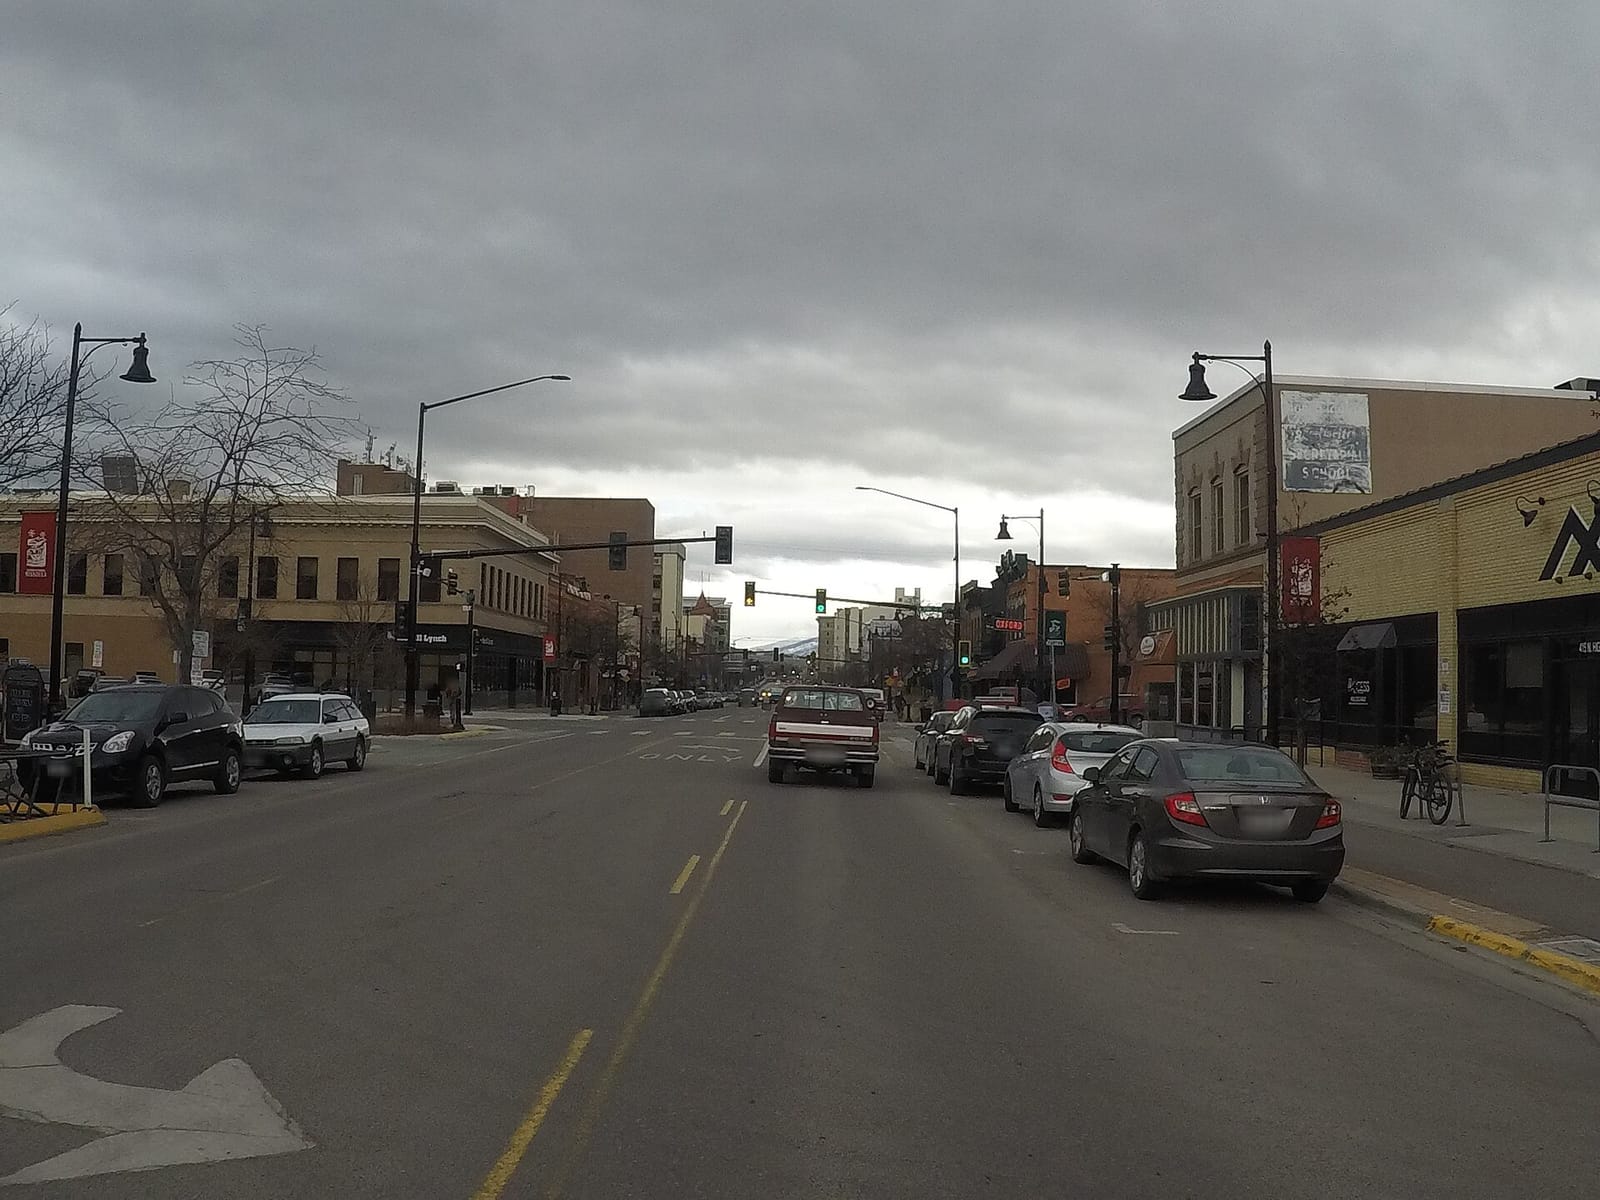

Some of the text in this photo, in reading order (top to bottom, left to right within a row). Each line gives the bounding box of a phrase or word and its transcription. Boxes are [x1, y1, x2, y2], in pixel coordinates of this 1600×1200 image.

[995, 619, 1023, 630] OXFORD
[423, 634, 447, 644] Lynch
[639, 753, 744, 762] ONLY
